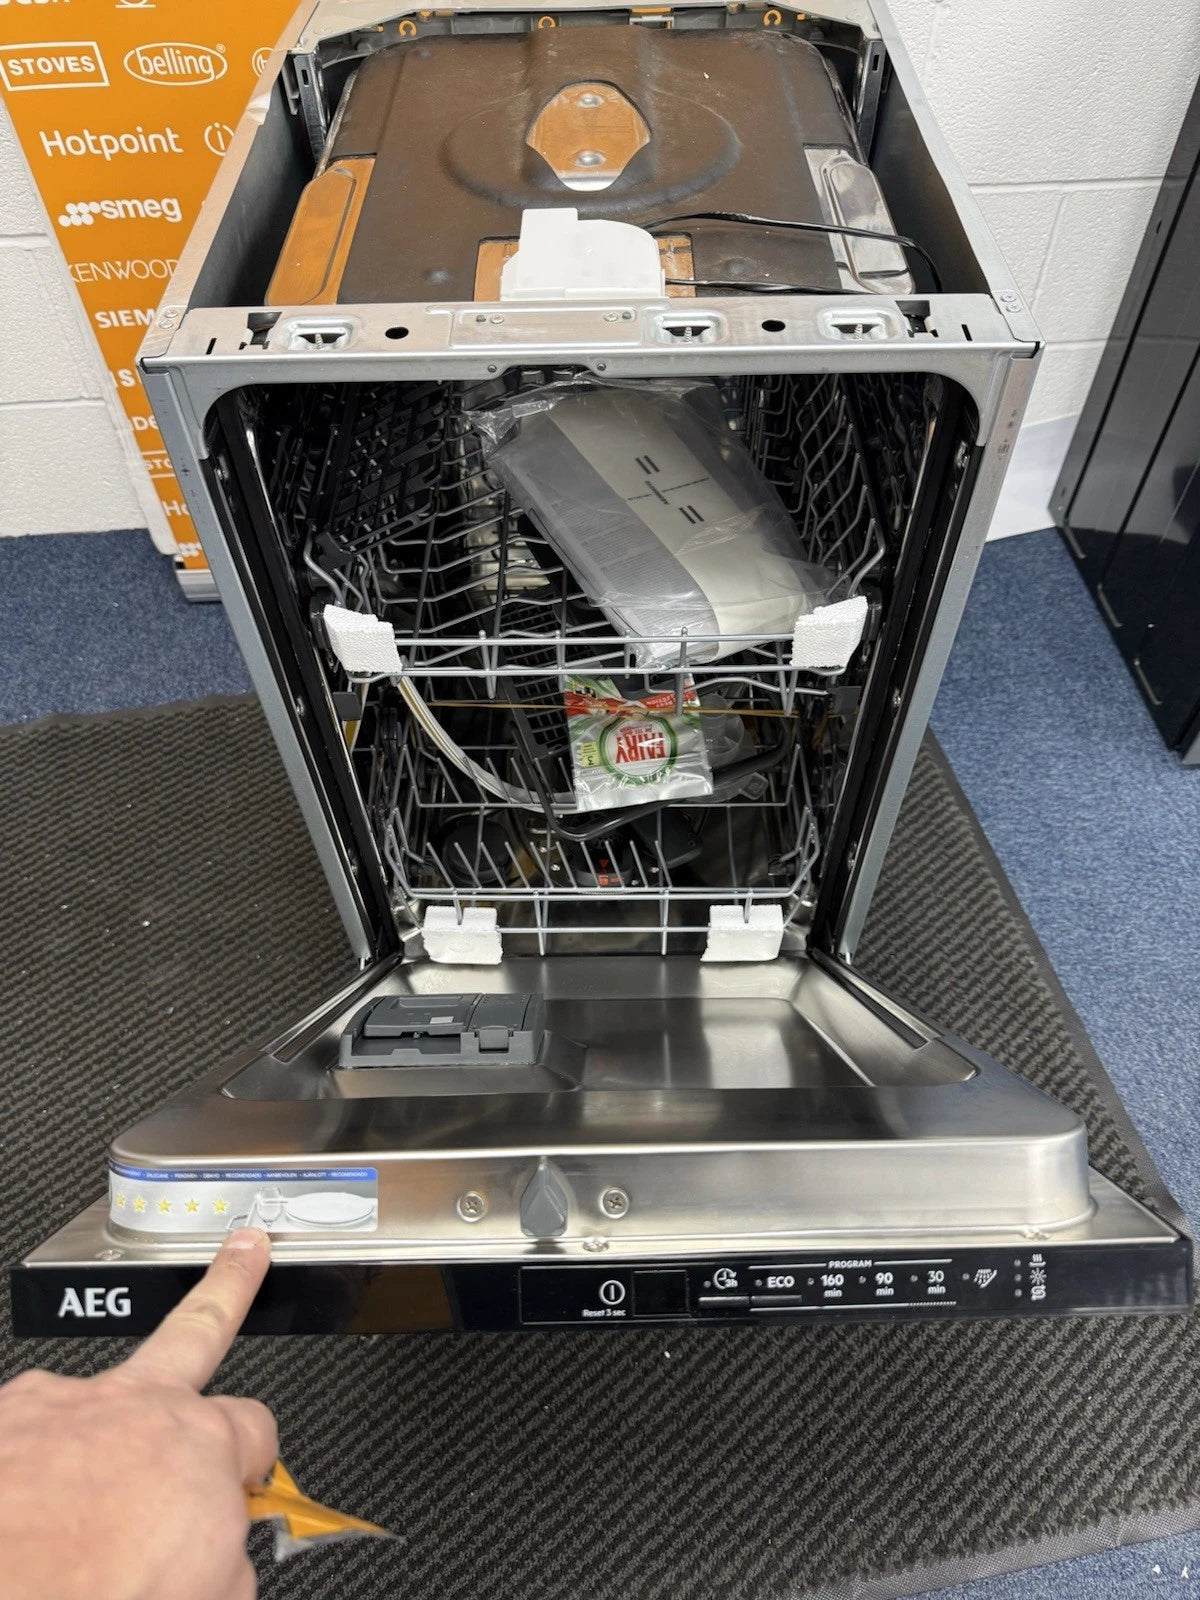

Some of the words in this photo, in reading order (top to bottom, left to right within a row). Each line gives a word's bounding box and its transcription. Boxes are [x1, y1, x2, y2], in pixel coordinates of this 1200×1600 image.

[7, 54, 96, 76] STOVES
[137, 48, 215, 80] belling
[39, 125, 184, 161] Hotpoint
[101, 197, 183, 223] smeg
[94, 308, 156, 329] SIEM
[615, 732, 666, 765] FAIRY
[828, 1259, 873, 1270] PROGRAM
[724, 1278, 738, 1288] 3h
[766, 1275, 796, 1289] ECO
[820, 1273, 845, 1287] 160
[875, 1271, 894, 1285] 90
[927, 1270, 945, 1283] 30
[823, 1287, 843, 1298] min
[875, 1285, 895, 1297] min
[927, 1284, 946, 1295] min
[57, 1286, 132, 1318] AEG
[581, 1308, 605, 1318] Reset
[605, 1308, 612, 1317] 3
